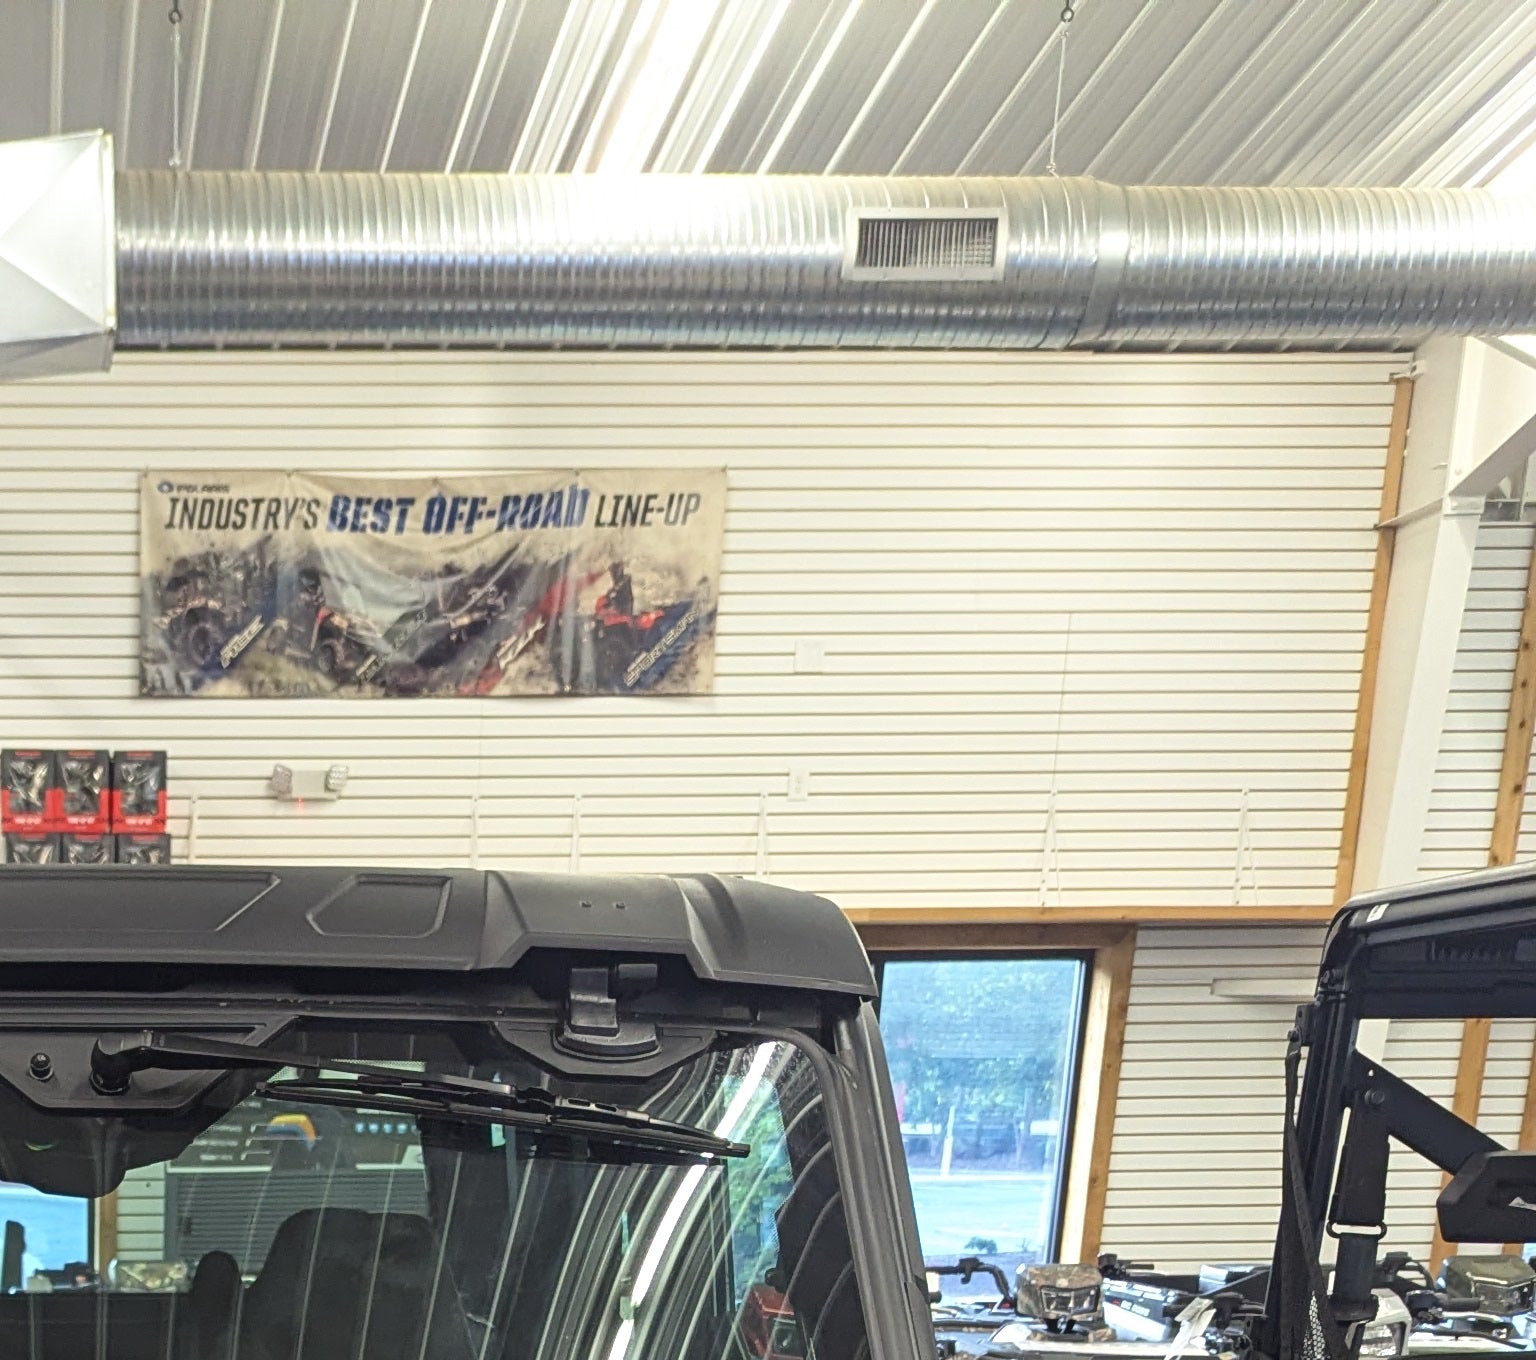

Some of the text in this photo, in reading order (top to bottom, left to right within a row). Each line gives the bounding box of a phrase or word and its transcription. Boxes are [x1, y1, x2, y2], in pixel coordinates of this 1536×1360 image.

[165, 482, 701, 534] INDUSTRY'S BEST OFF-ROAD LINE-UP
